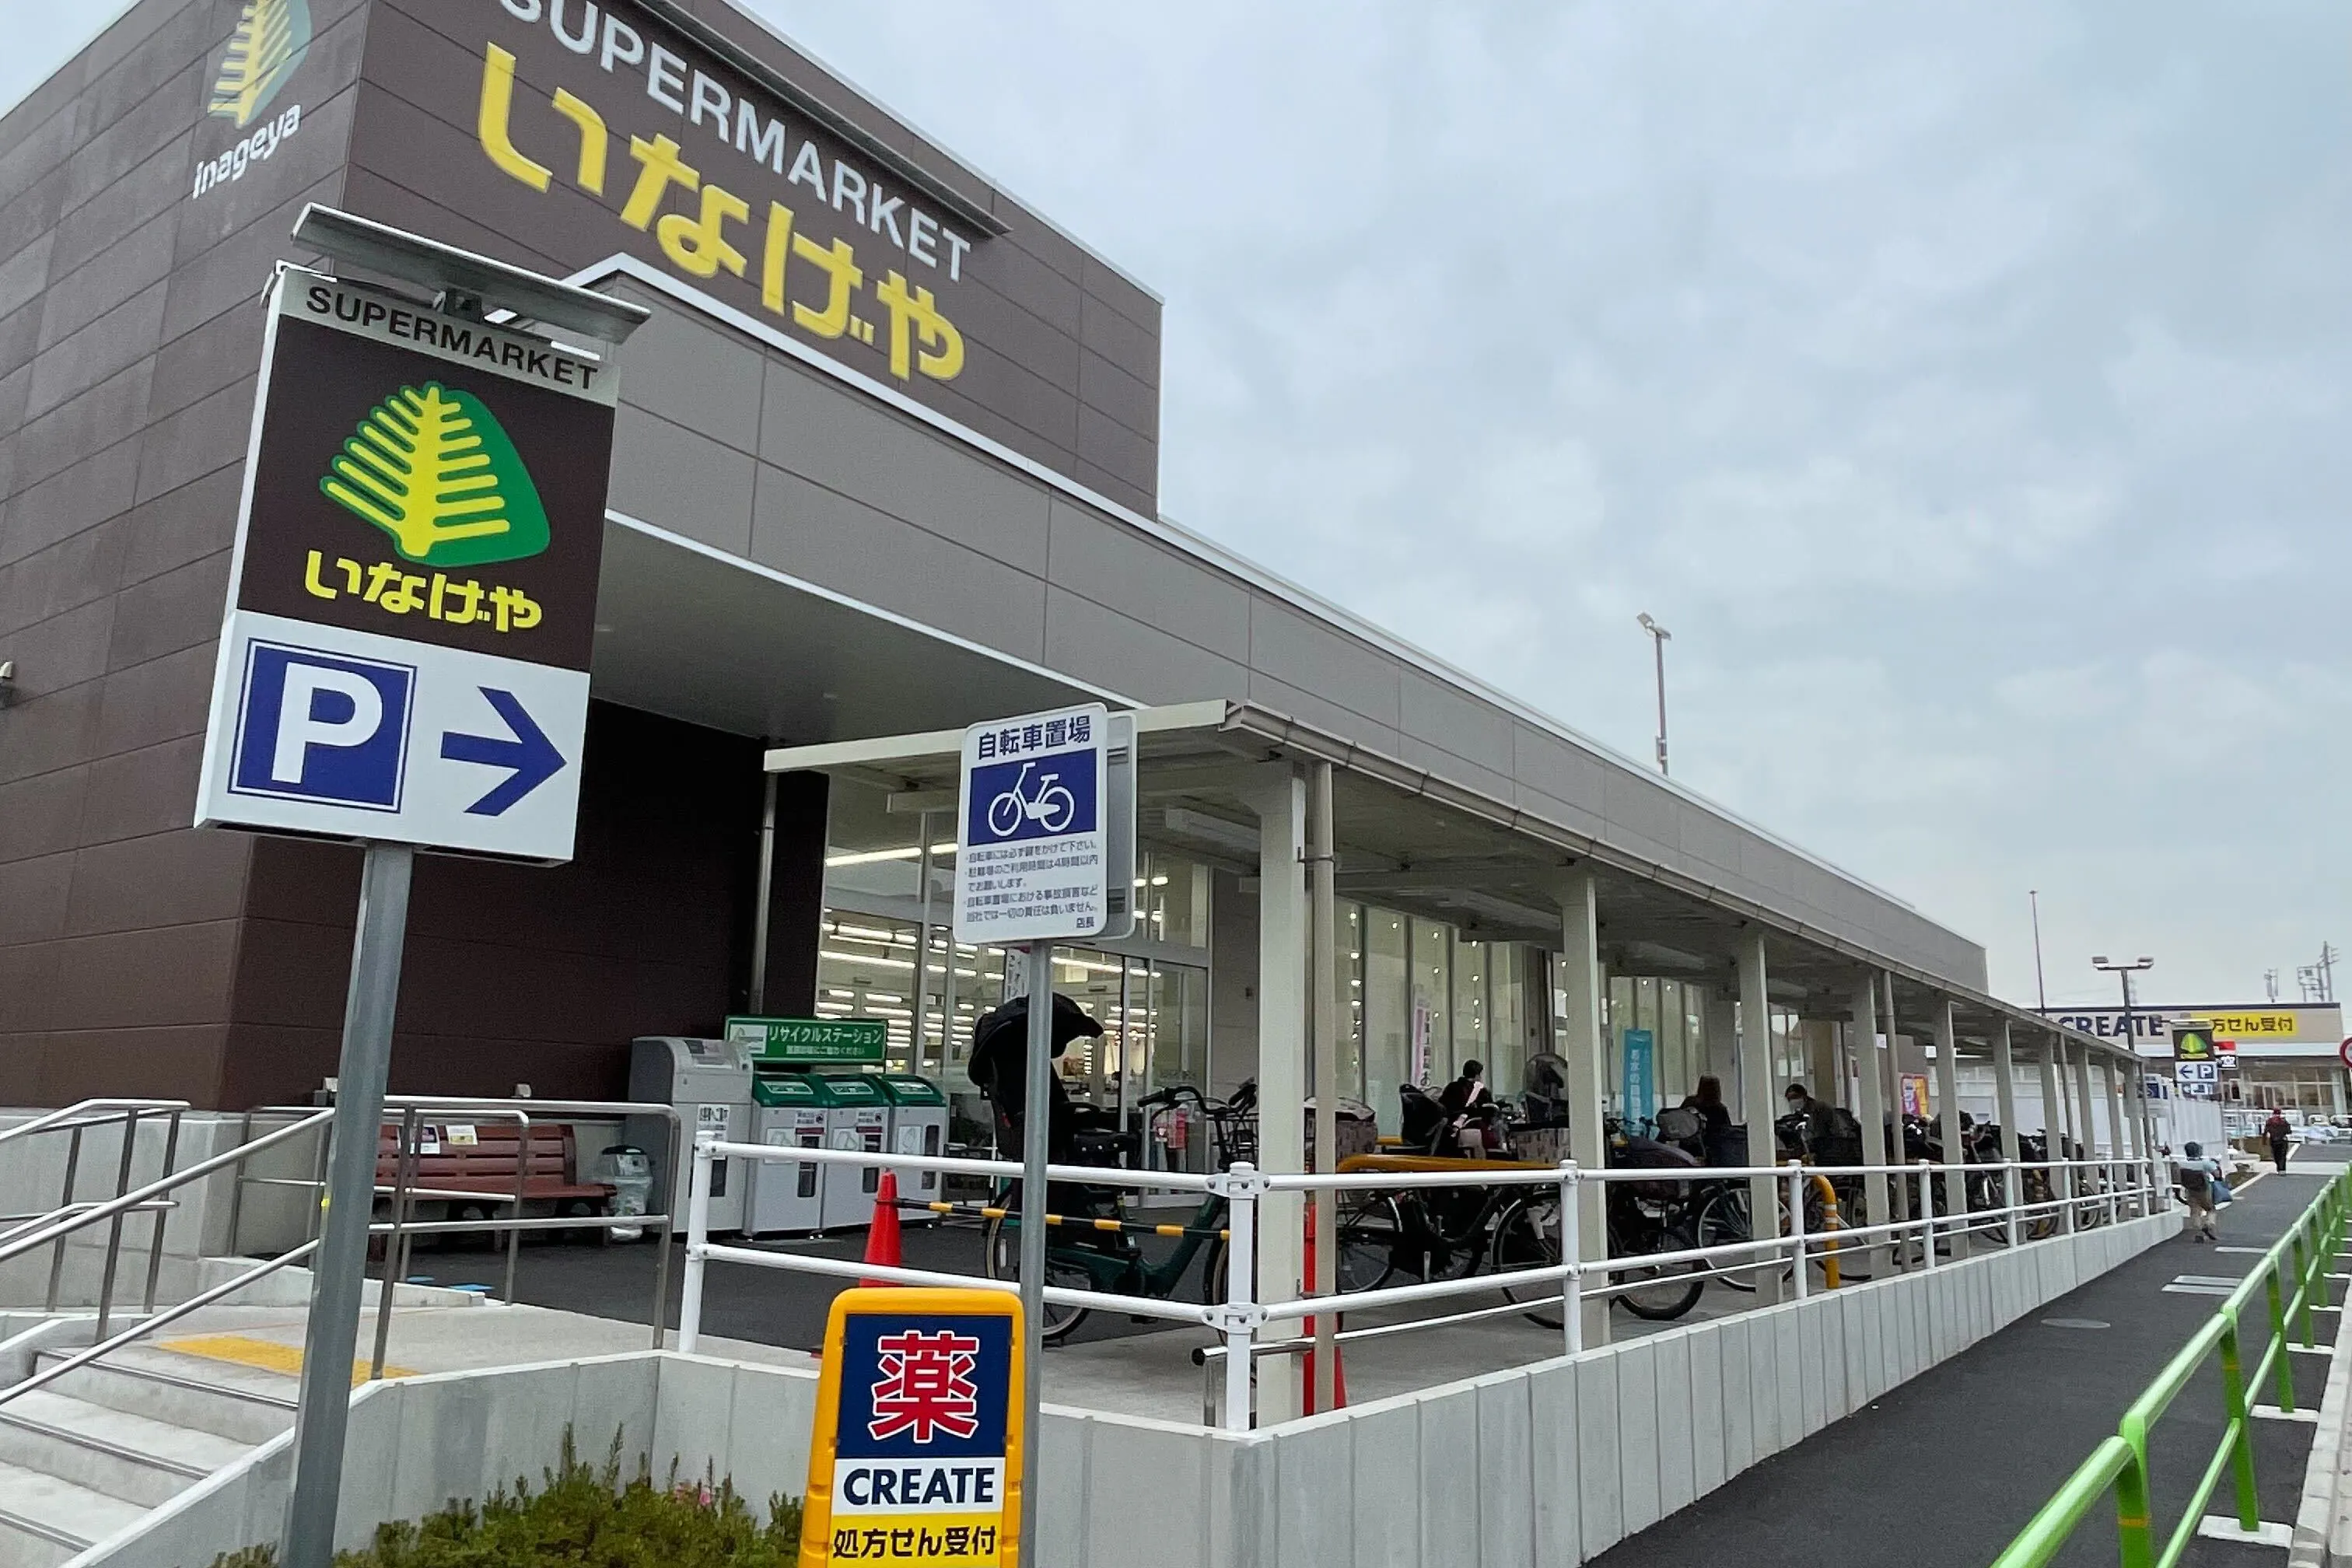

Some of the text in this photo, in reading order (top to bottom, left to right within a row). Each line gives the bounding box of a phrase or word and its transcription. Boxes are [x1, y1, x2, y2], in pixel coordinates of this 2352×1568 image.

[192, 103, 301, 199] inageya
[478, 41, 965, 381] いなげや
[306, 285, 600, 390] SUPERMARKET
[303, 549, 542, 632] いなげや
[271, 662, 383, 785] P
[978, 715, 1090, 760] 自転車置場
[768, 1025, 882, 1044] リサイクルステーション
[2200, 1065, 2212, 1078] P
[867, 1330, 980, 1444] 薬
[843, 1467, 995, 1506] CREATE
[832, 1524, 996, 1559] 処方せん受付
